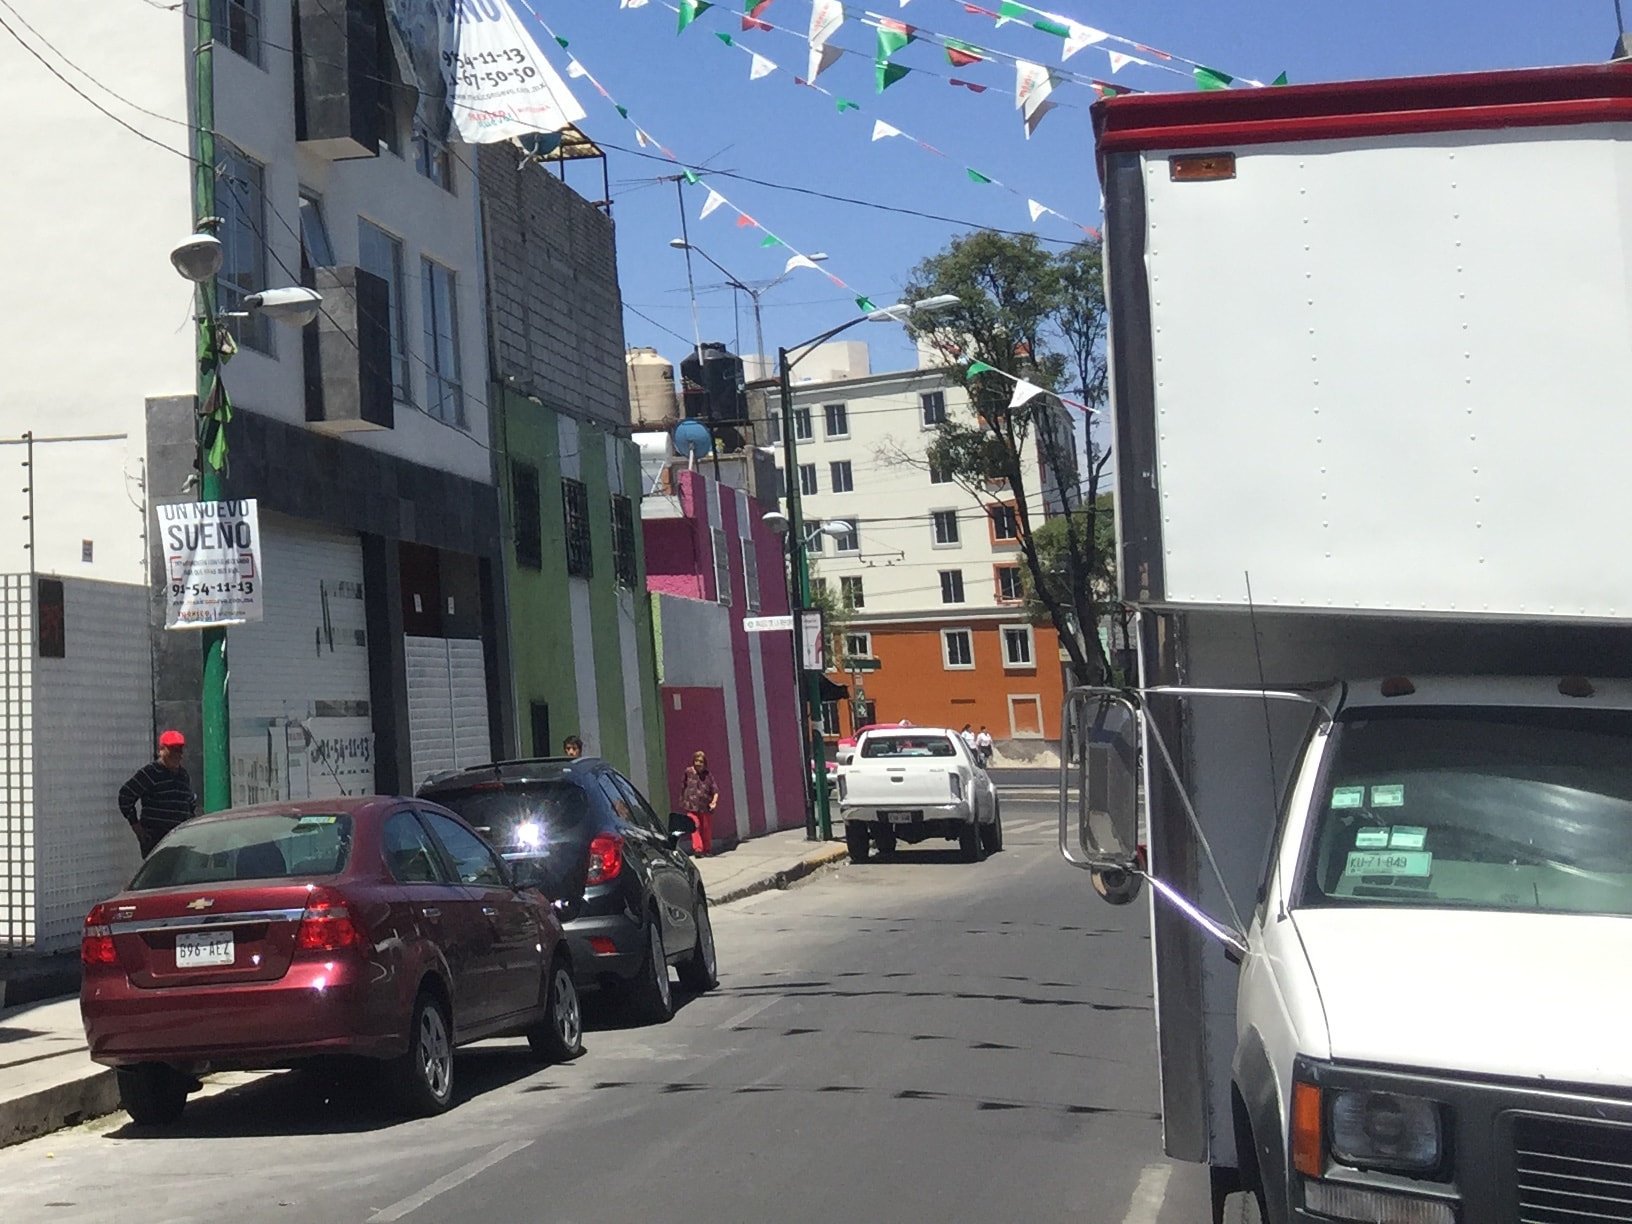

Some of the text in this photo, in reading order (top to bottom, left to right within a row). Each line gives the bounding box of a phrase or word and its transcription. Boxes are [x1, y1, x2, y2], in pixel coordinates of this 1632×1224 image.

[164, 500, 249, 520] UN NUEVO
[168, 521, 252, 552] SUEÑO
[172, 582, 253, 597] 91-54-11-13
